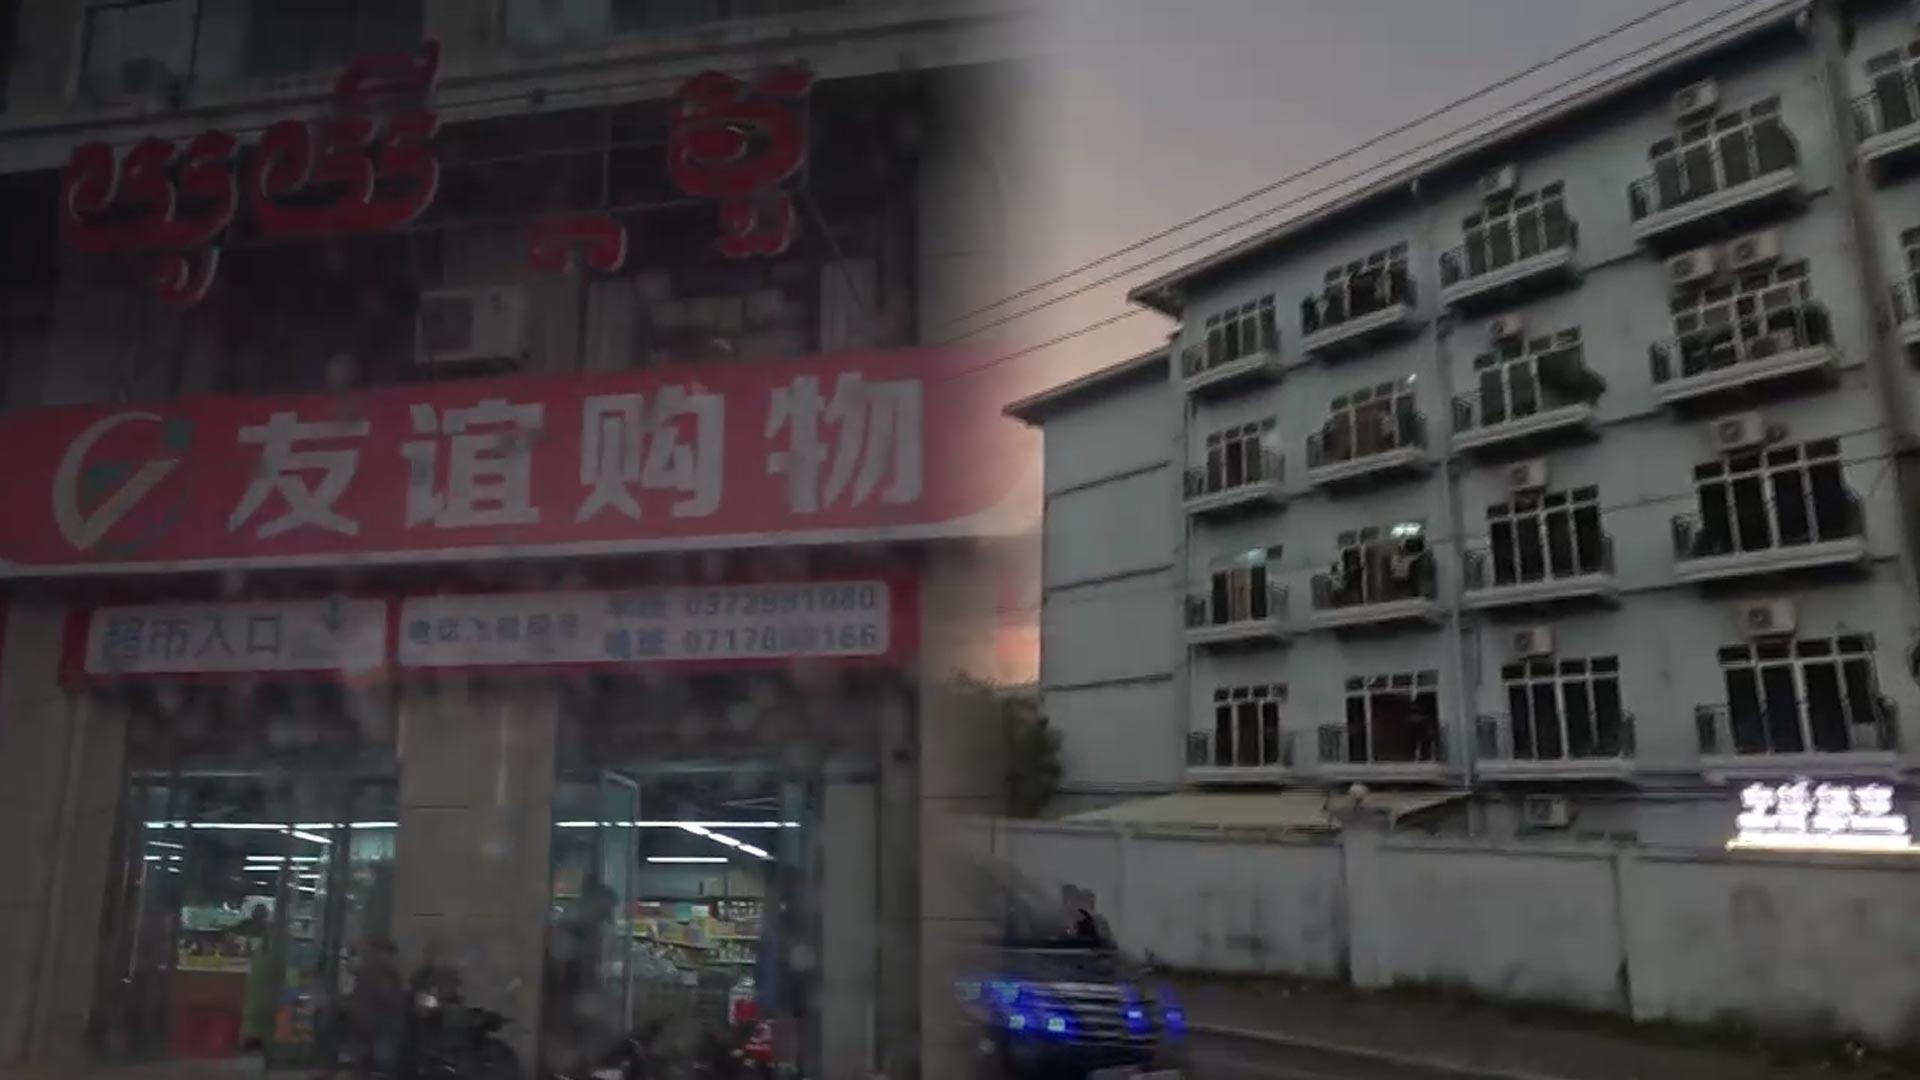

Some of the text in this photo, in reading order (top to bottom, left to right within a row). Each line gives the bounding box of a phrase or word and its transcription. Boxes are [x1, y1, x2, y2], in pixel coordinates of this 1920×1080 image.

[227, 373, 924, 538] 友谊购物
[101, 615, 280, 660] 超市入口
